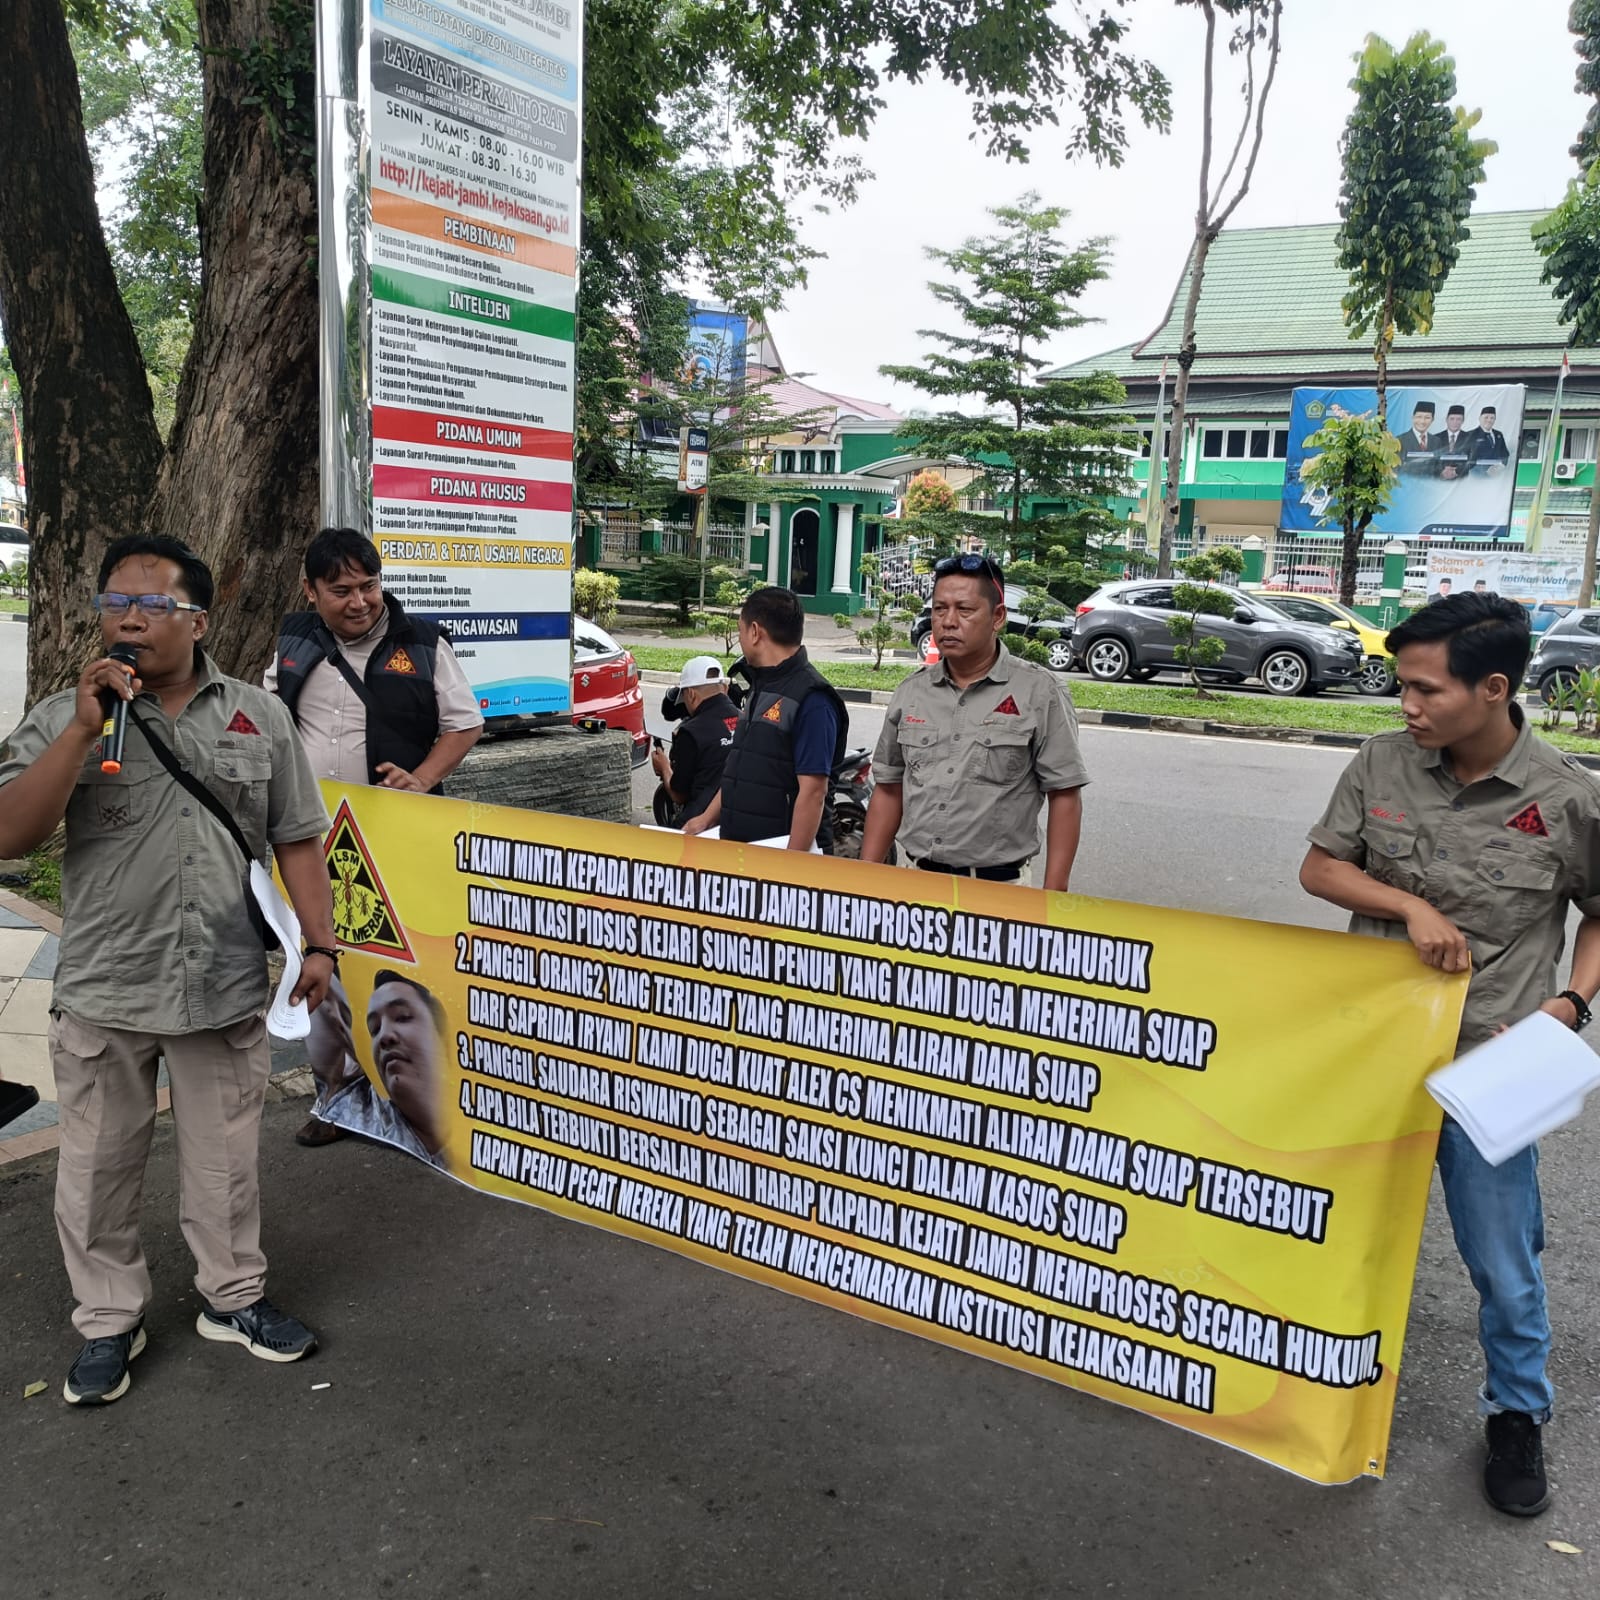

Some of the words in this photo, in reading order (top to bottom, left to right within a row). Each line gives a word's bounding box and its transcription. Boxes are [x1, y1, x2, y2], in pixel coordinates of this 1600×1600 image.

[529, 0, 570, 30] JAMBI
[432, 7, 472, 40] DATANG
[474, 27, 488, 47] DI
[488, 31, 512, 58] ZONA
[514, 43, 568, 81] INTEGRITAS
[383, 38, 458, 92] LAYANAN
[461, 70, 568, 135] PERKANTORAN
[387, 101, 422, 124] SENIN
[434, 118, 470, 142] KAMIS
[480, 135, 507, 156] 08.00
[518, 149, 544, 169] 16.00
[546, 160, 565, 176] WIB
[380, 142, 406, 158] LAYANAN
[408, 151, 416, 162] INI
[418, 155, 435, 168] DAPAT
[436, 162, 459, 176] DIAKSES
[460, 170, 466, 179] DI
[466, 172, 487, 186] ALAMAT
[488, 178, 508, 193] WEBSITE
[510, 184, 536, 202] KEJAKSAAN
[472, 151, 500, 172] 08.30
[510, 164, 537, 184] 16.30
[380, 155, 569, 234] http://kejati-jambi.kejaksaan.go.id
[444, 216, 515, 255] PEMBINAAN
[448, 290, 510, 321] INTELIJEN
[436, 420, 484, 444] PIDANA
[486, 428, 522, 449] UMUM
[380, 446, 406, 458] Layanan
[407, 450, 424, 460] Surat
[424, 451, 466, 465] Perpanjangan
[466, 456, 498, 468] Penahanan
[430, 477, 478, 498] PIDANA
[480, 482, 526, 502] KHUSUS
[380, 505, 406, 516] Layanan
[406, 507, 424, 516] Surat
[436, 509, 474, 520] Mengunjungi
[475, 512, 498, 522] Tahanan
[380, 518, 406, 528] Layanan
[406, 520, 424, 530] Surat
[424, 521, 465, 532] Perpanjangan
[466, 523, 497, 534] Penahanan
[380, 540, 438, 560] PERDATA
[440, 543, 450, 560] &
[452, 544, 482, 562] TATA
[483, 545, 521, 562] USAHA
[522, 546, 566, 564] NEGARA
[1430, 565, 1464, 574] Sukses
[407, 574, 428, 582] Hukum
[1500, 574, 1539, 584] Imtihan
[438, 618, 518, 636] PENGAWASAN
[334, 850, 360, 866] LSM
[352, 899, 385, 942] MERAH
[456, 832, 468, 870] 1.
[470, 834, 512, 876] KAMI
[512, 840, 564, 888] MINTA
[566, 850, 630, 899] KEPADA
[632, 860, 696, 910] KEPALA
[698, 872, 758, 920] KEJATI
[758, 881, 819, 932] JAMBI
[820, 892, 949, 954] MEMPROSES
[950, 914, 1004, 964] ALEX
[1005, 922, 1150, 990] HUTAHURUK
[468, 886, 532, 928] MANTAN
[534, 899, 573, 942] KASI
[574, 906, 638, 955] PIDSUS
[640, 917, 699, 966] KEJARI
[701, 928, 770, 980] SUNGAI
[773, 940, 837, 994] PENUH
[840, 954, 892, 1004] YANG
[895, 964, 952, 1016] KAMI
[954, 976, 1016, 1030] DUGA
[1018, 987, 1142, 1056] MENERIMA
[1144, 1012, 1214, 1068] SUAP
[456, 934, 472, 972] 2.
[472, 938, 538, 986] PANGGIL
[539, 950, 604, 1002] ORANG2
[606, 964, 651, 1014] YANG
[652, 974, 734, 1029] TERLIBAT
[735, 990, 784, 1040] YANG
[786, 1002, 892, 1064] MANERIMA
[894, 1025, 969, 1080] ALIRAN
[972, 1041, 1031, 1097] DANA
[1034, 1056, 1098, 1110] SUAP
[468, 987, 506, 1030] DARI
[506, 996, 575, 1048] SAPRIDA
[577, 1012, 632, 1060] IRYANI
[636, 1024, 684, 1074] KAMI
[684, 1035, 734, 1084] DUGA
[736, 1048, 786, 1098] KUAT
[786, 1060, 833, 1110] ALEX
[834, 1071, 862, 1118] CS
[864, 1078, 982, 1146] MENIKMATI
[984, 1107, 1066, 1168] ALIRAN
[1064, 1126, 1128, 1186] DANA
[1128, 1143, 1196, 1203] SUAP
[1198, 1162, 1330, 1240] TERSEBUT
[458, 1033, 474, 1069] 3.
[473, 1036, 536, 1088] PANGGIL
[538, 1054, 612, 1108] SAUDARA
[612, 1074, 702, 1134] RISWANTO
[704, 1097, 782, 1156] SEBAGAI
[784, 1118, 843, 1172] SAKSI
[844, 1132, 910, 1190] KUNCI
[912, 1151, 987, 1211] DALAM
[986, 1168, 1060, 1233] KASUS
[1062, 1192, 1124, 1252] SUAP
[460, 1080, 475, 1116] 4.
[475, 1084, 506, 1125] APA
[504, 1092, 541, 1136] BILA
[540, 1102, 616, 1160] TERBUKTI
[617, 1126, 702, 1185] BERSALAH
[704, 1150, 752, 1201] KAMI
[754, 1166, 816, 1219] HARAP
[818, 1183, 896, 1244] KAPADA
[897, 1206, 966, 1266] KEJATI
[964, 1226, 1032, 1288] JAMBI
[1032, 1247, 1178, 1335] MEMPROSES
[1180, 1292, 1280, 1368] SECARA
[470, 1131, 522, 1180] KAPAN
[520, 1148, 569, 1198] PERLU
[566, 1162, 619, 1213] PECAT
[616, 1178, 684, 1235] MEREKA
[685, 1198, 732, 1252] YANG
[732, 1213, 790, 1270] TELAH
[786, 1232, 938, 1320] MENCEMARKAN
[936, 1282, 1044, 1356] INSTITUSI
[1048, 1320, 1181, 1400] KEJAKSAAN
[1184, 1362, 1212, 1410] RI
